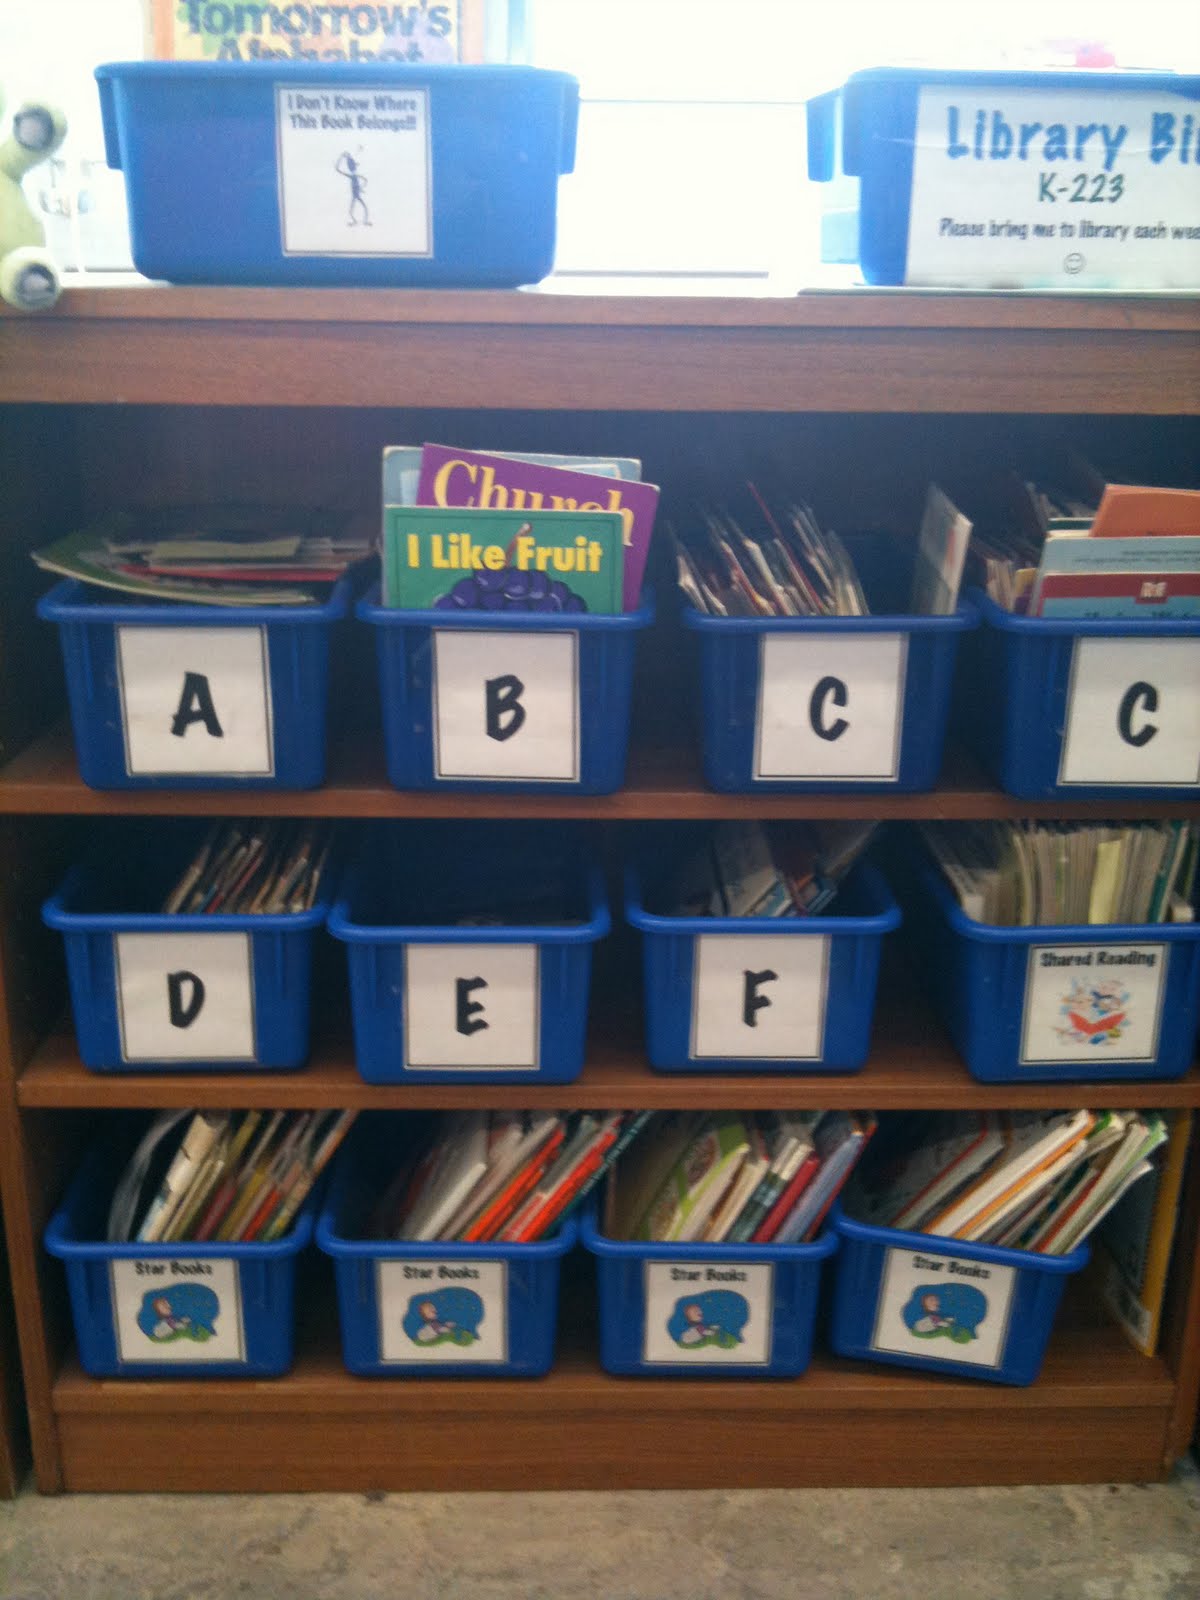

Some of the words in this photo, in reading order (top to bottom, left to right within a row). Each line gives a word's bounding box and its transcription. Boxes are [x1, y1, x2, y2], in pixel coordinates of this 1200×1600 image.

[179, 0, 453, 37] Tomorrow's
[216, 38, 424, 61] Alhbt
[289, 114, 318, 129] This
[321, 114, 353, 129] Book
[296, 95, 330, 111] Don't
[334, 95, 370, 111] Know
[374, 96, 417, 111] Where
[945, 105, 1127, 171] Library
[1149, 112, 1200, 165] Bi
[1037, 172, 1126, 203] K-223
[939, 218, 985, 236] Please
[988, 220, 1028, 240] bring
[1032, 224, 1055, 238] me
[1059, 222, 1076, 238] to
[1078, 220, 1129, 242] library
[1133, 221, 1167, 239] each
[433, 459, 635, 547] Chuh
[407, 534, 420, 568] I
[431, 533, 506, 570] Like
[515, 536, 603, 572] Fruit
[171, 671, 223, 737] A
[485, 674, 526, 742] B
[809, 676, 850, 742] C
[1118, 681, 1159, 748] C
[1040, 952, 1092, 967] Shared
[1096, 951, 1156, 968] Reading
[167, 970, 205, 1029] D
[455, 976, 489, 1036] E
[743, 969, 778, 1028] F
[135, 1260, 165, 1275] Star
[170, 1261, 213, 1275] Books
[403, 1265, 433, 1279] Star
[438, 1265, 480, 1279] Books
[670, 1267, 700, 1281] Star
[706, 1268, 747, 1282] Books
[912, 1255, 944, 1271] Star
[948, 1261, 991, 1279] Books
